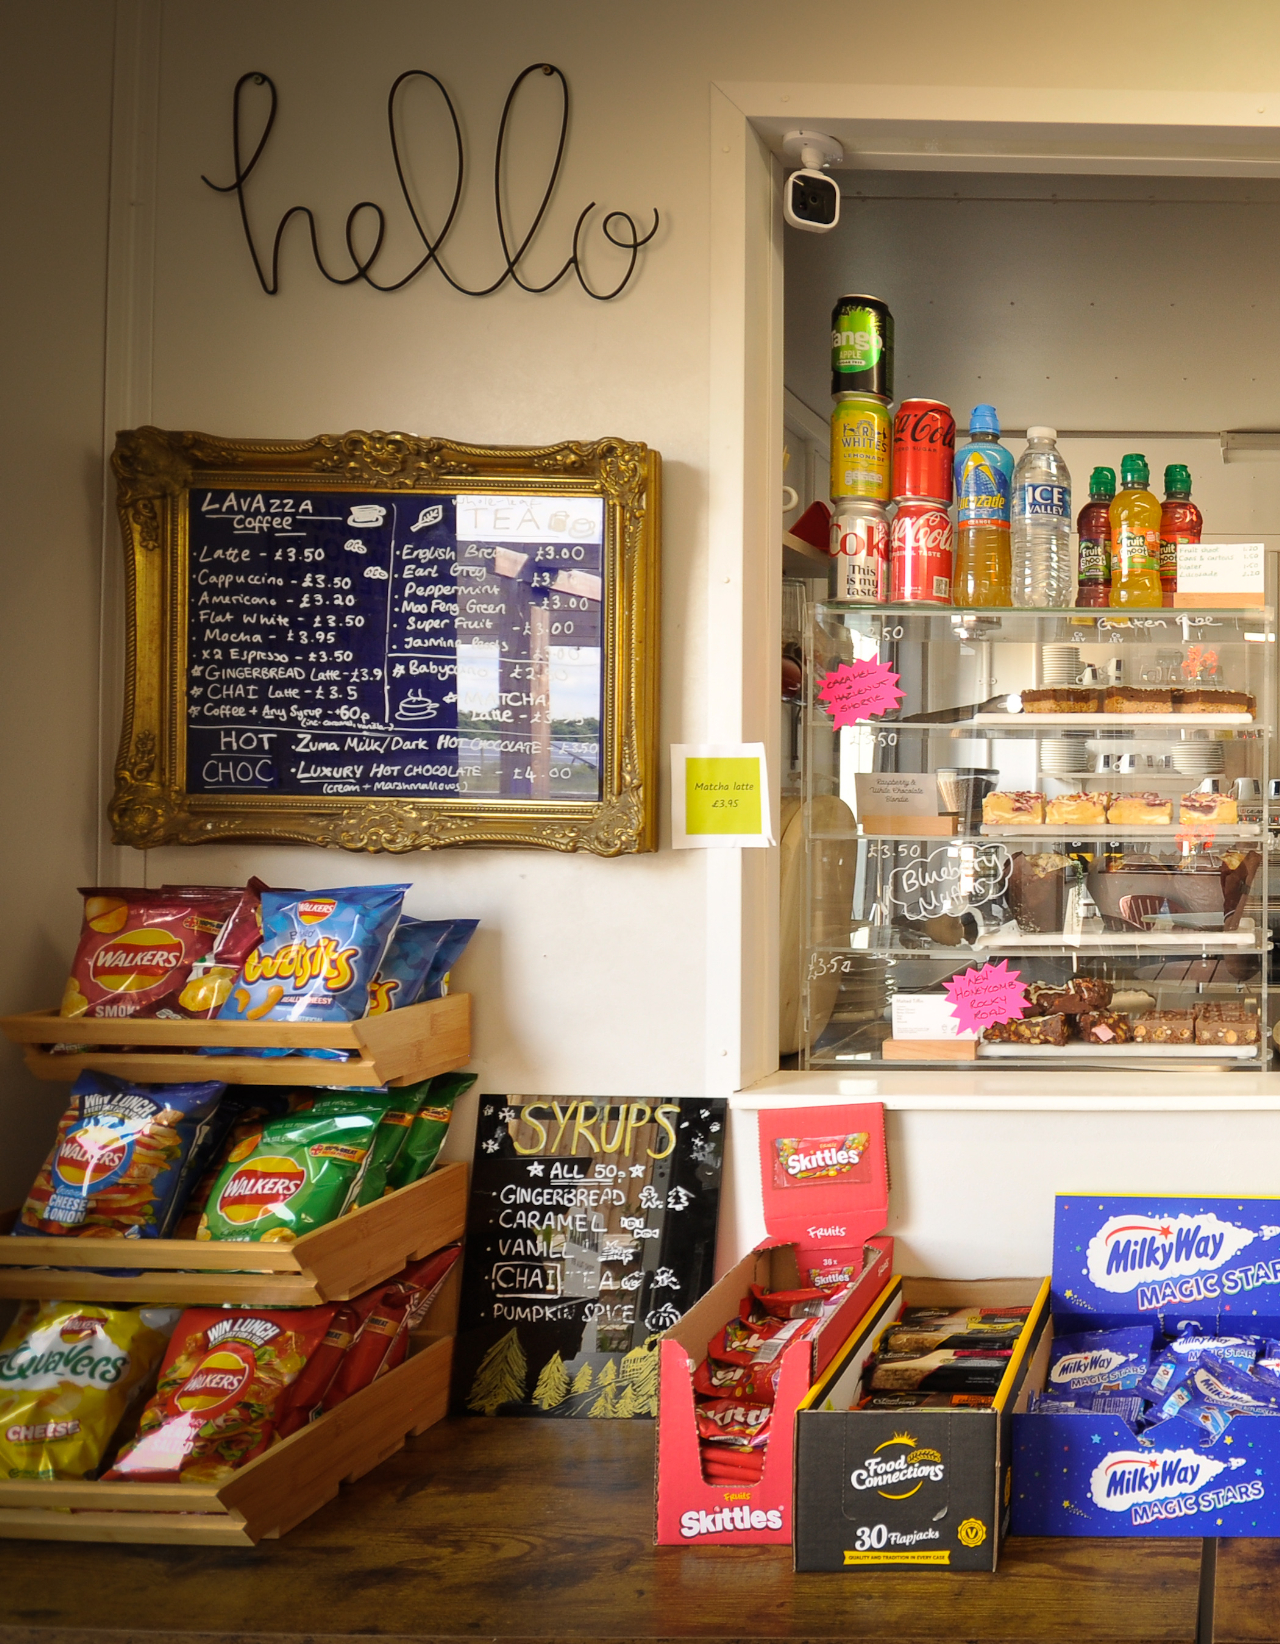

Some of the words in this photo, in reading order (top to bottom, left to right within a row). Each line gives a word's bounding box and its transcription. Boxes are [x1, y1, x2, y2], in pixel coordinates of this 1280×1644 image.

[201, 62, 660, 301] hello
[841, 436, 889, 453] WHITES
[843, 453, 886, 463] LEMONADE
[1028, 485, 1065, 506] ICE
[1027, 504, 1065, 516] VALLEY
[233, 515, 293, 533] Coffee
[198, 545, 252, 564] Latte
[273, 547, 326, 563] £3.50
[401, 544, 457, 563] English
[535, 545, 586, 562] £3.00
[1081, 547, 1103, 557] Fruit
[197, 568, 284, 588] Cappuccino
[301, 573, 353, 590] £3.50
[402, 564, 439, 579] Earl
[449, 563, 488, 582] Grey
[848, 564, 877, 576] This
[404, 583, 501, 599] Peppermint
[846, 574, 855, 586] is
[858, 577, 880, 590] my
[197, 591, 278, 606] Americano
[299, 593, 356, 609] £3.20
[846, 587, 879, 598] taste
[430, 599, 460, 617] Feng
[465, 600, 507, 615] Green
[198, 609, 235, 625] Flat
[242, 612, 291, 628] White
[312, 615, 366, 629] £3.50
[405, 616, 450, 632] Super
[453, 616, 494, 630] Fruit
[203, 628, 263, 643] Mocha
[286, 629, 337, 644] £3.95
[229, 648, 290, 664] Espresso
[308, 650, 354, 663] £3.50
[204, 664, 306, 681] GINGERBREAD
[309, 667, 342, 682] Latte
[206, 683, 260, 700] CHAI
[268, 685, 302, 699] Latte
[203, 702, 247, 718] Coffee
[261, 704, 288, 722] Any
[289, 705, 324, 721] Syrup
[220, 730, 278, 751] HOT
[296, 733, 341, 753] Zuma
[436, 734, 463, 750] HOT
[202, 759, 274, 783] CHOC
[296, 761, 364, 780] LUXURY
[369, 763, 402, 779] HOT
[403, 764, 483, 778] CHOCOLATE
[512, 766, 572, 783] £4.00
[694, 781, 730, 791] Matcha
[732, 781, 755, 791] latte
[711, 799, 740, 808] £3.95
[95, 949, 181, 969] WALKERS
[954, 981, 1018, 999] HONEYCOMB
[969, 996, 1008, 1009] ROCKY
[973, 1007, 1008, 1021] ROAD
[111, 1093, 158, 1116] LUNCH
[513, 1100, 682, 1160] SYRUPS
[787, 1148, 860, 1175] Skittles
[550, 1161, 585, 1180] ALL
[594, 1163, 627, 1184] 50p
[223, 1176, 303, 1199] WALKERS
[499, 1184, 627, 1207] GINGERBREAD
[49, 1194, 88, 1212] CHEESE
[50, 1209, 87, 1224] ONION
[499, 1209, 608, 1234] CARAMEL
[806, 1225, 848, 1240] Fruits
[496, 1266, 557, 1290] CHAI
[814, 1273, 851, 1287] Skittles
[1138, 1273, 1220, 1311] MAGIC
[581, 1303, 636, 1324] SPICE
[206, 1320, 231, 1343] WIN
[232, 1317, 282, 1340] LUNCH
[1, 1340, 128, 1384] Quavers
[1070, 1373, 1107, 1390] MAGIC
[1108, 1365, 1148, 1383] STARS
[6, 1418, 82, 1442] CHEESE
[864, 1454, 908, 1475] Food
[850, 1464, 945, 1490] Connections
[723, 1492, 752, 1502] Fruits
[1131, 1493, 1199, 1527] MAGIC
[1199, 1480, 1266, 1511] STARS
[679, 1505, 784, 1538] Skittles
[854, 1524, 888, 1551] 30
[888, 1527, 941, 1547] Flapjacks
